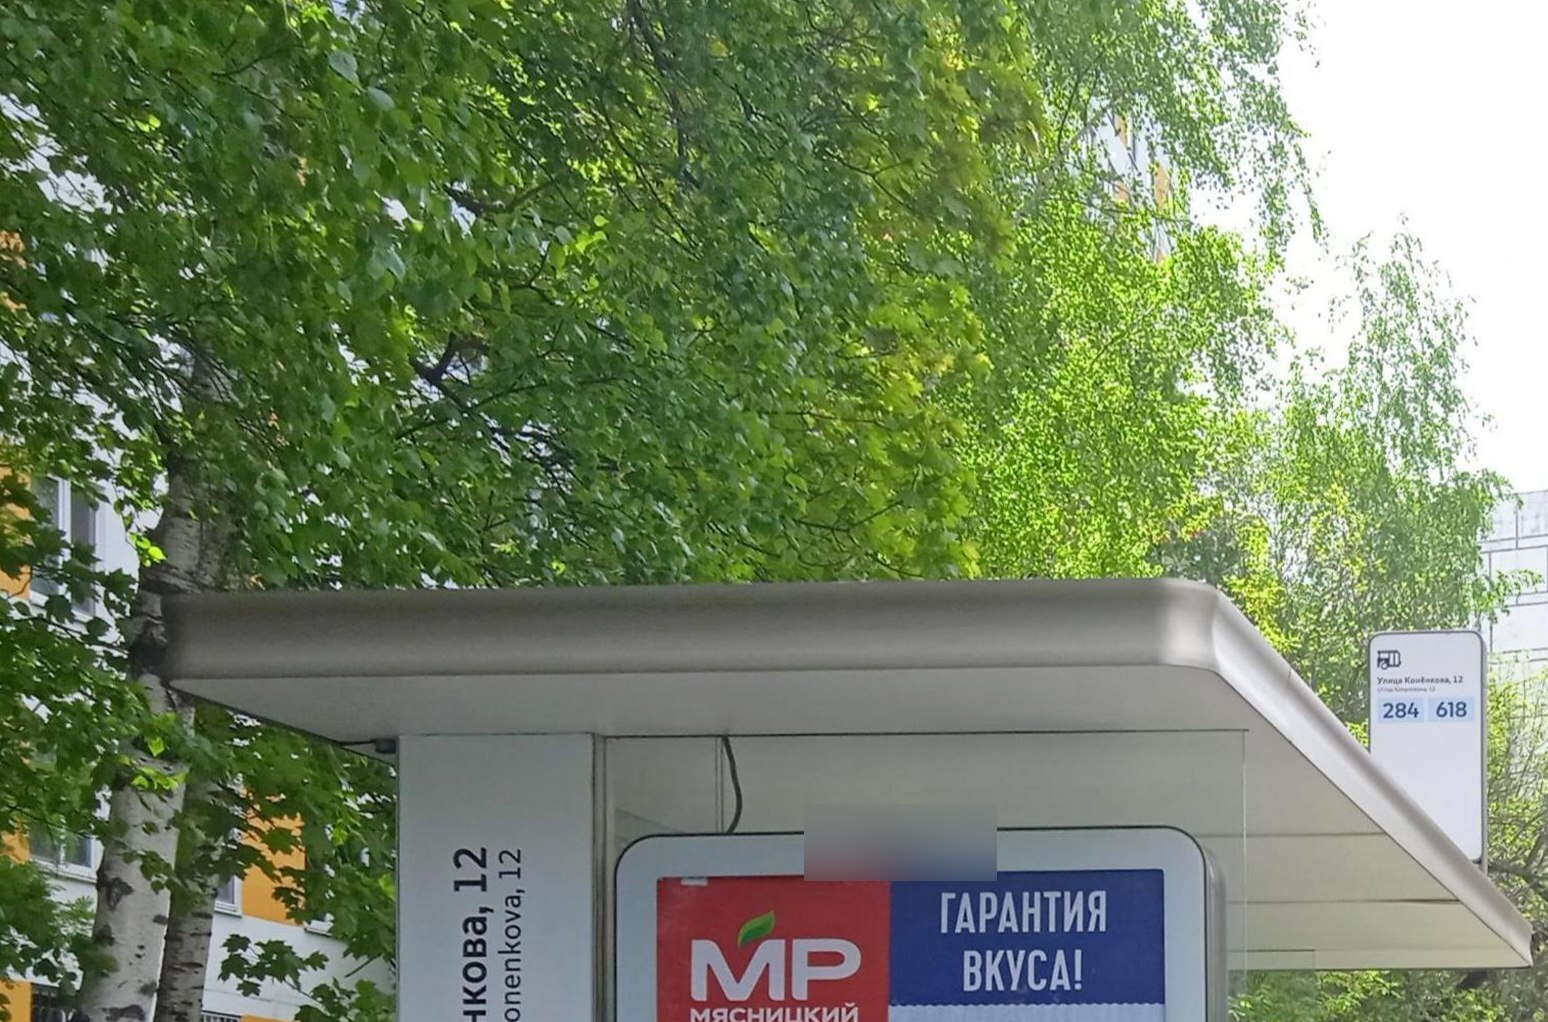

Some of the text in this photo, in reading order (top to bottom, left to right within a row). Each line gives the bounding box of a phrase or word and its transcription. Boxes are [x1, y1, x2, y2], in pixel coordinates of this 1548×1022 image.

[1453, 675, 1463, 684] 12
[1383, 702, 1419, 718] 284
[1436, 701, 1467, 718] 618
[453, 846, 488, 893] 12
[498, 847, 521, 880] 12
[940, 890, 1107, 934] ГАРАНТИЯ
[691, 938, 862, 1001] МР
[963, 949, 1082, 992] ВКУСА!
